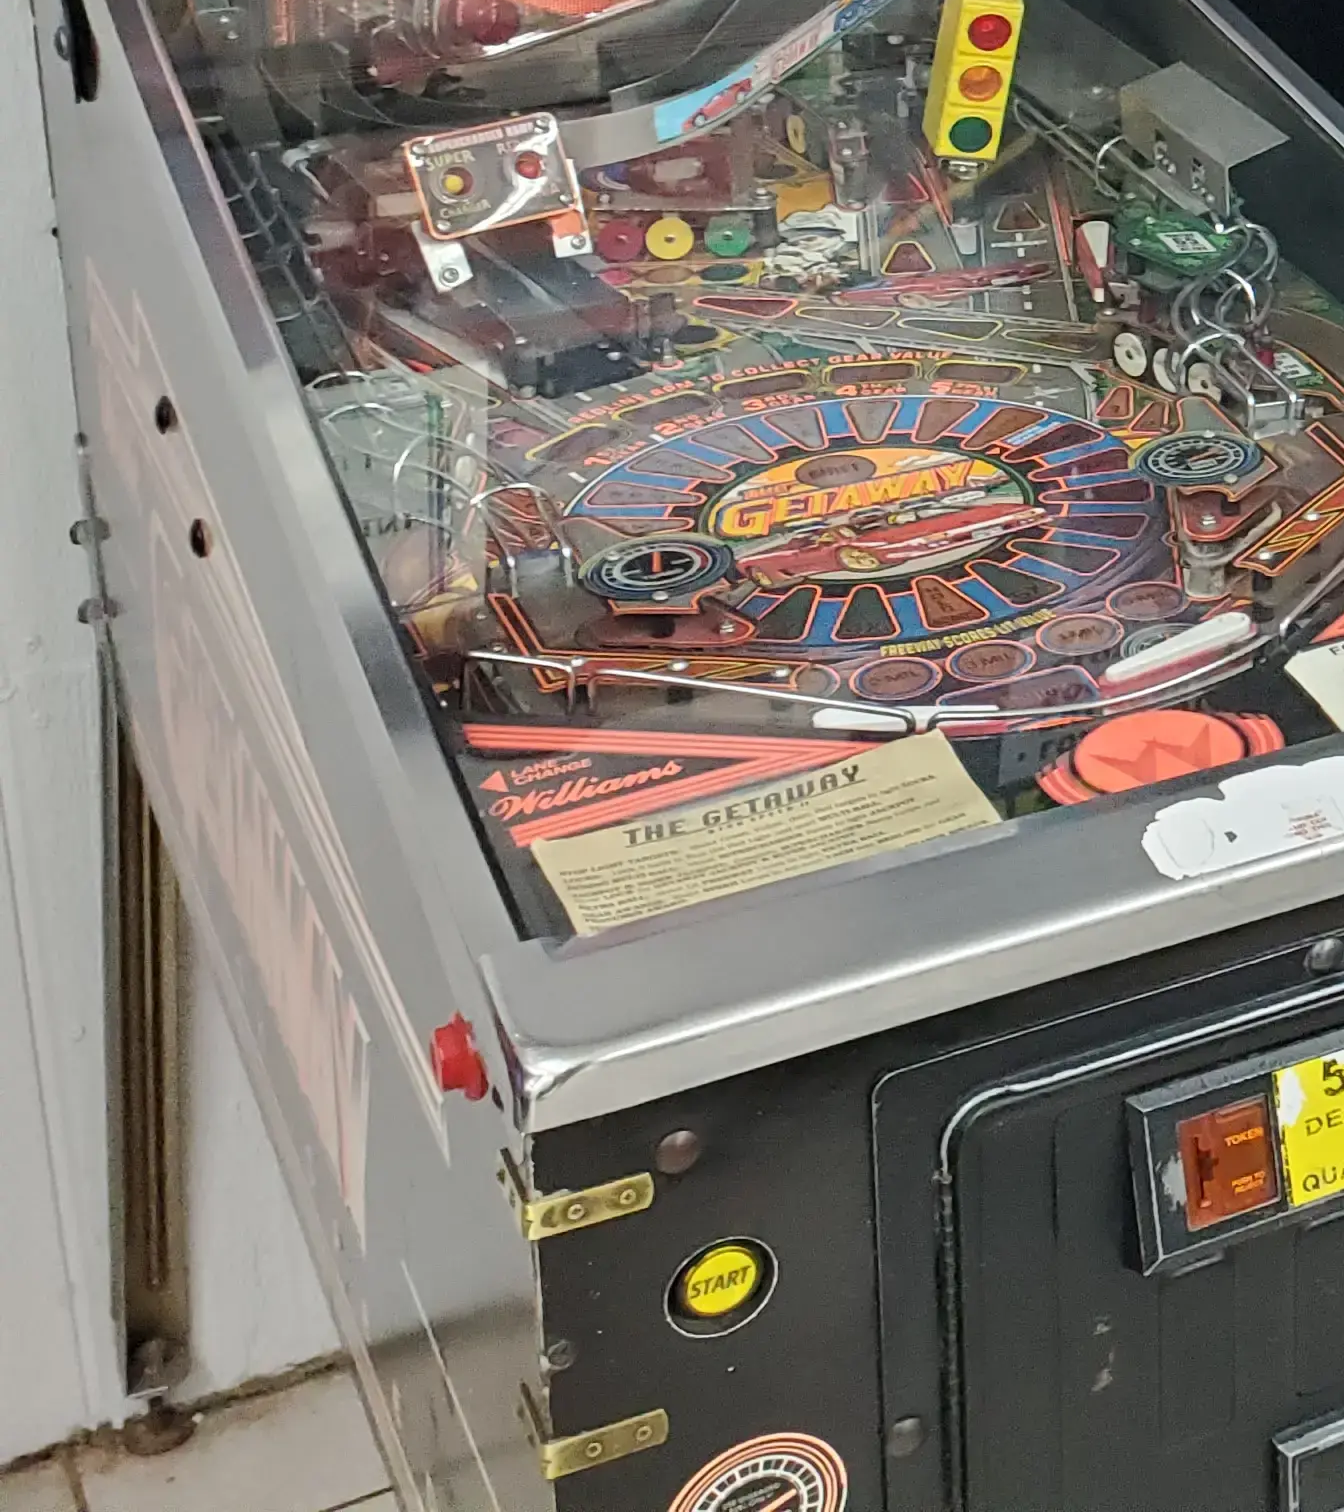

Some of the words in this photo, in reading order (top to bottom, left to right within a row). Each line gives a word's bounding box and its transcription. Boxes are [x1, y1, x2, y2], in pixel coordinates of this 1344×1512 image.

[425, 149, 476, 172] SUPER
[568, 388, 647, 424] REDLINE
[731, 357, 821, 379] COLLECT
[828, 351, 882, 365] GEAR
[889, 350, 953, 362] VALUE
[717, 459, 974, 538] GETAWAY
[880, 636, 943, 657] FREEWAY
[943, 626, 998, 648] SCORES
[510, 758, 558, 778] LANE
[513, 758, 593, 787] CHANGE
[490, 759, 684, 821] Williams
[622, 821, 682, 848] THE
[701, 764, 861, 826] GETAWAY
[1223, 1126, 1265, 1148] TOKEN
[1231, 1175, 1256, 1188] PUSH
[690, 1264, 752, 1300] START
